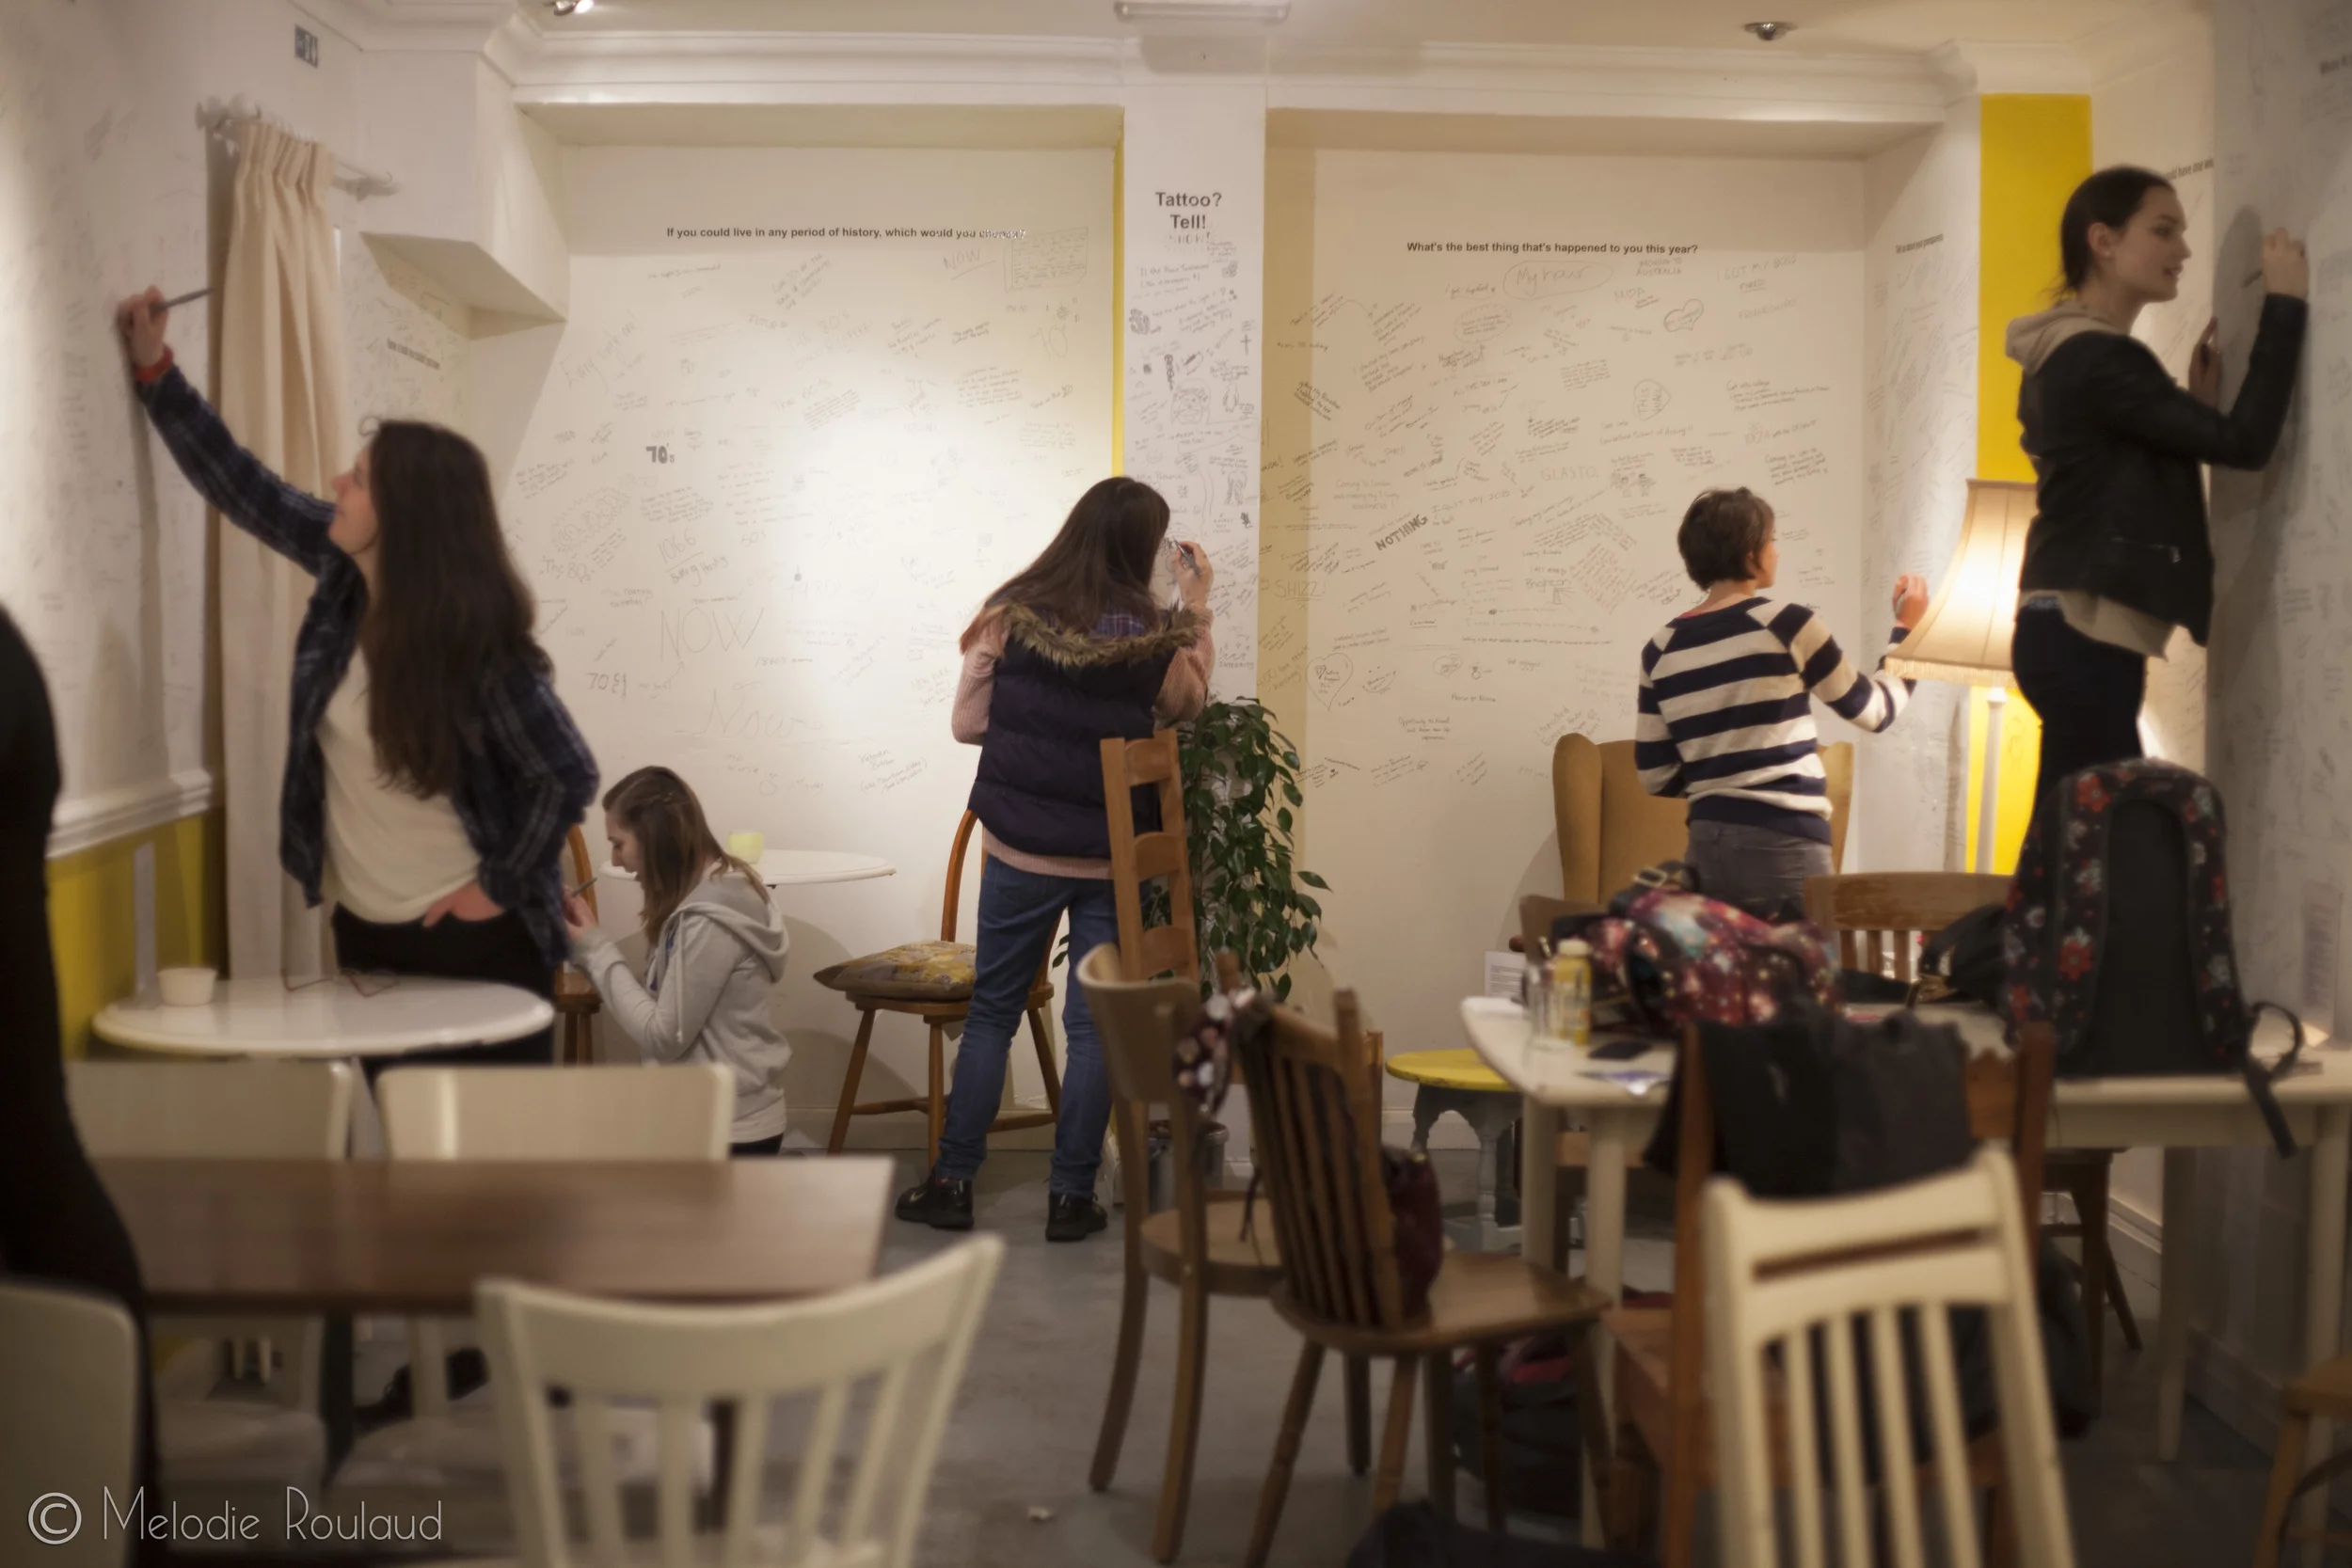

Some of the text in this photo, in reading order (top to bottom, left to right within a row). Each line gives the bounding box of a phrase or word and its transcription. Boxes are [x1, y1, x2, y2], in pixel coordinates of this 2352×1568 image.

[1154, 191, 1222, 208] Tattoo?
[1169, 214, 1206, 230] Tell!
[666, 227, 675, 238] If
[676, 229, 697, 240] you
[699, 227, 731, 238] could
[733, 227, 753, 238] live
[755, 227, 766, 238] in
[768, 229, 788, 240] any
[790, 227, 826, 240] period
[828, 227, 840, 238] of
[842, 227, 882, 240] history,
[884, 227, 917, 238] which
[920, 227, 953, 239] would
[956, 230, 977, 241] you
[944, 247, 980, 269] NOW
[1406, 242, 1698, 256] What's the best thing that's happened to you this year?
[1636, 267, 1682, 277] AUSTRALIA
[1724, 265, 1747, 281] GOT
[1751, 260, 1769, 273] MY
[645, 442, 675, 465] 70's
[1335, 479, 1392, 491] Coming to London
[1441, 500, 1464, 512] QUIT
[1487, 490, 1511, 500] JOB
[1375, 515, 1428, 549] NOTHING
[657, 527, 696, 563] 1066
[541, 558, 565, 575] The
[660, 608, 765, 661] NOW
